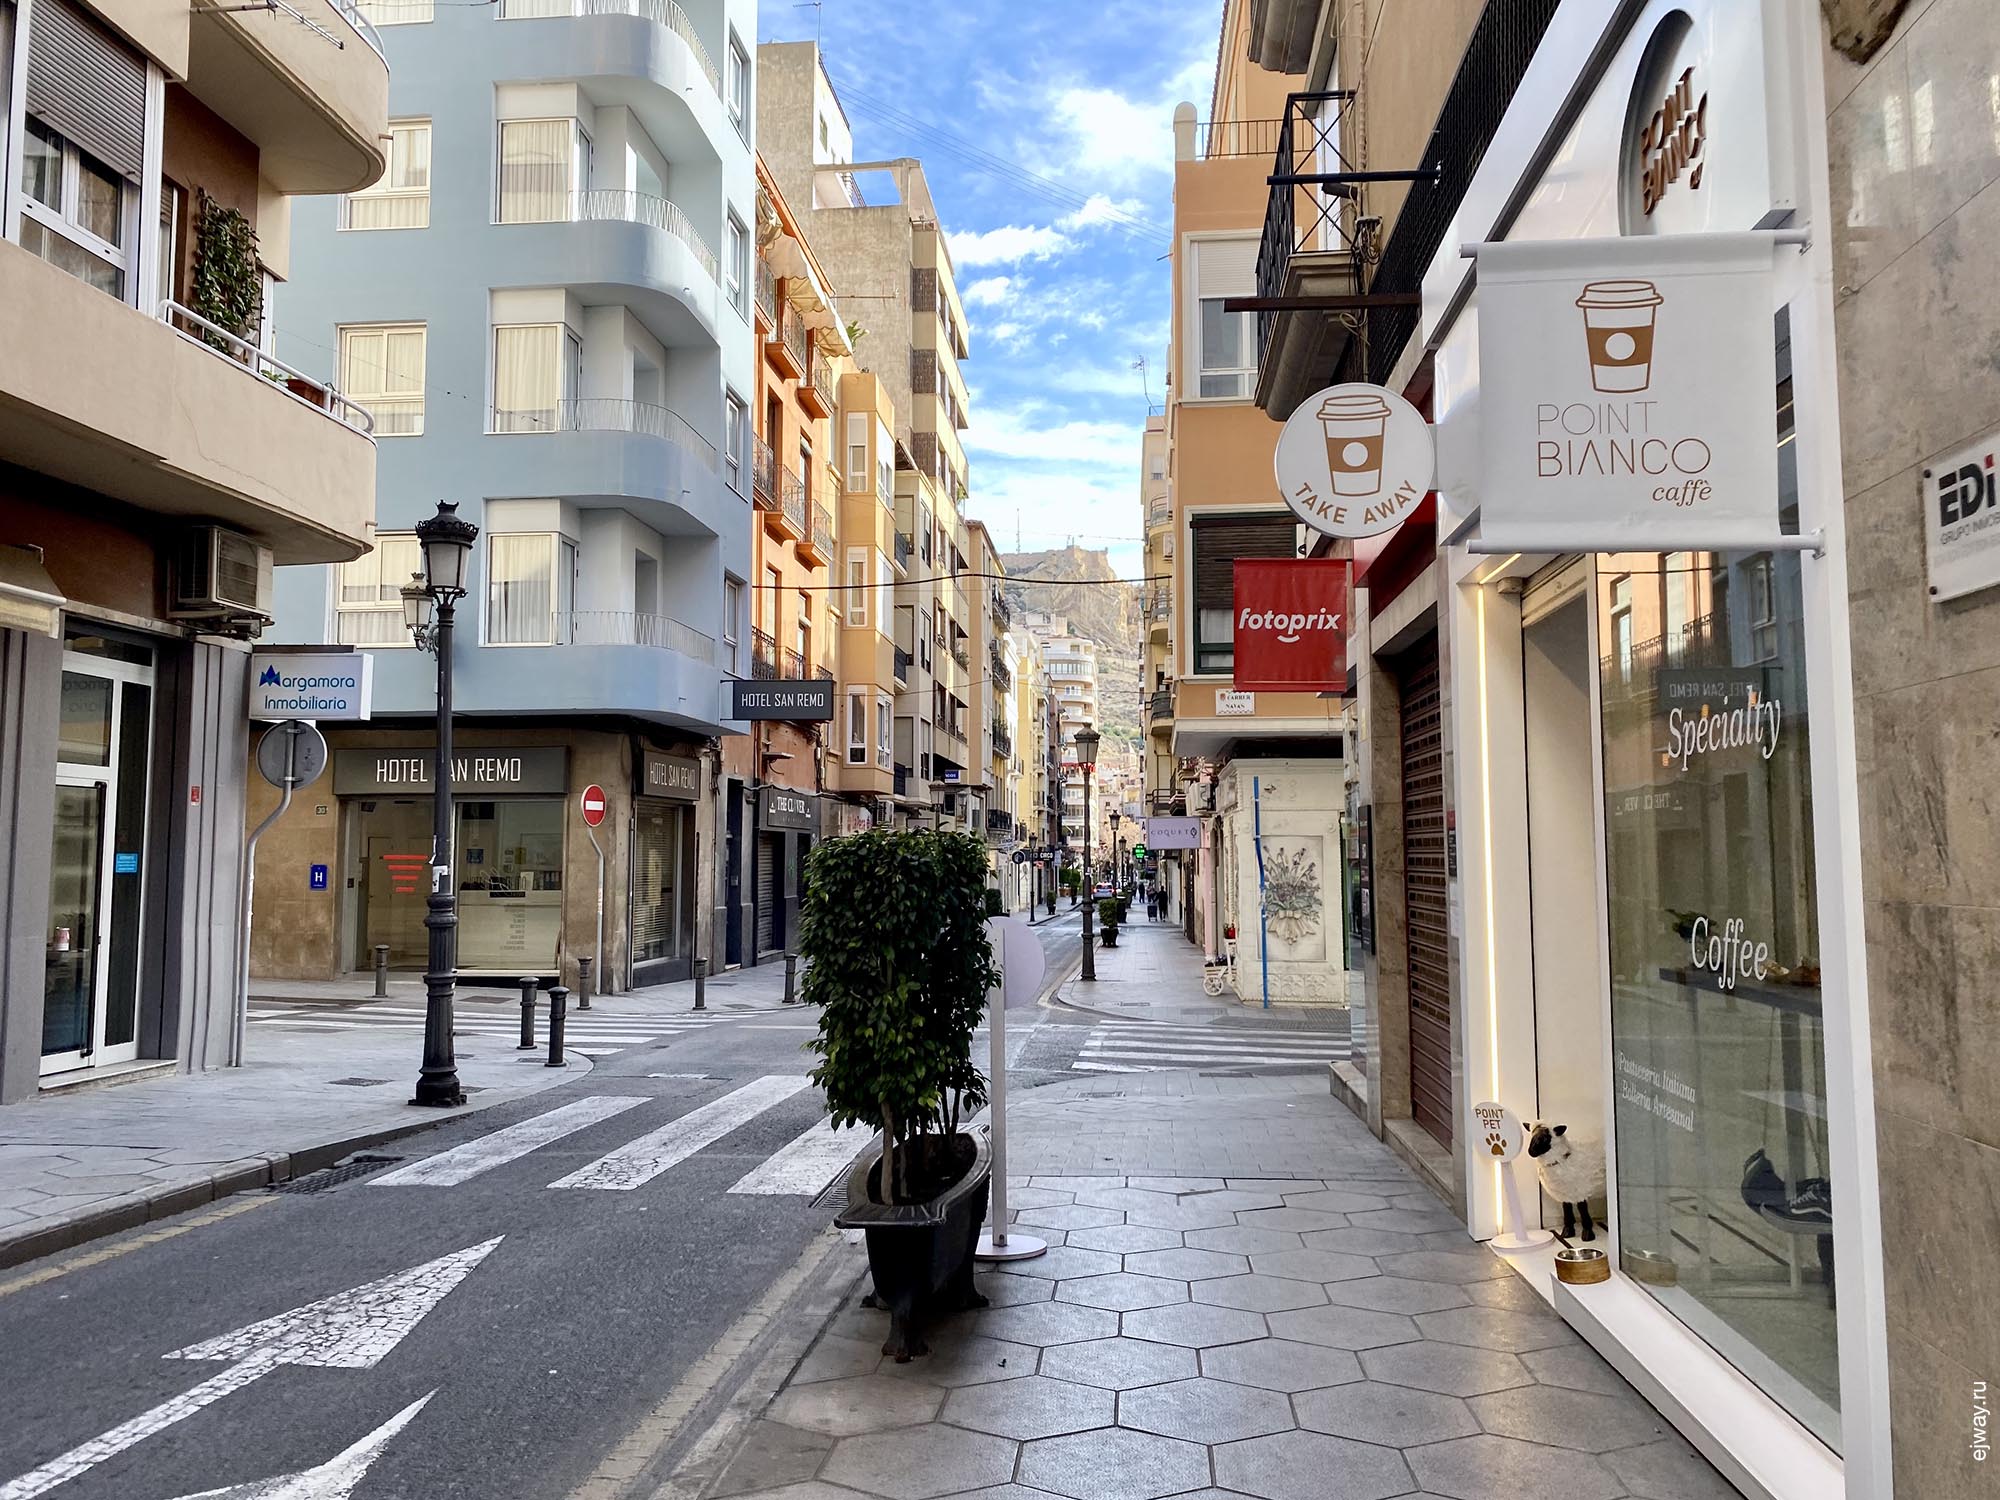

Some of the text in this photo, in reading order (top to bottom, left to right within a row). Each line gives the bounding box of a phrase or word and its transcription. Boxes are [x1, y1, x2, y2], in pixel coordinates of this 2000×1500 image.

[1641, 66, 1696, 170] POINT
[1537, 401, 1658, 435] POINT
[1537, 438, 1711, 477] BIANCO
[1295, 479, 1417, 525] TAKE AWAY
[1652, 478, 1712, 507] caffè
[1940, 523, 1970, 545] GRUPO
[1238, 607, 1341, 635] fotoprix
[258, 664, 355, 692] Margamora
[264, 695, 347, 709] Inmobiliaria
[741, 692, 824, 708] HOTEL SAN REMO
[1669, 685, 1781, 771] Specialty
[376, 758, 521, 783] HOTEL AN REMO
[650, 761, 696, 790] HOTEL SAN REMO
[776, 796, 806, 814] THE CLVER
[315, 872, 323, 882] H
[1691, 916, 1768, 989] Coffee
[1662, 1069, 1696, 1103] Italiana
[1475, 1108, 1504, 1119] POINT
[1483, 1119, 1501, 1129] PET
[1652, 1094, 1694, 1132] Artesanal
